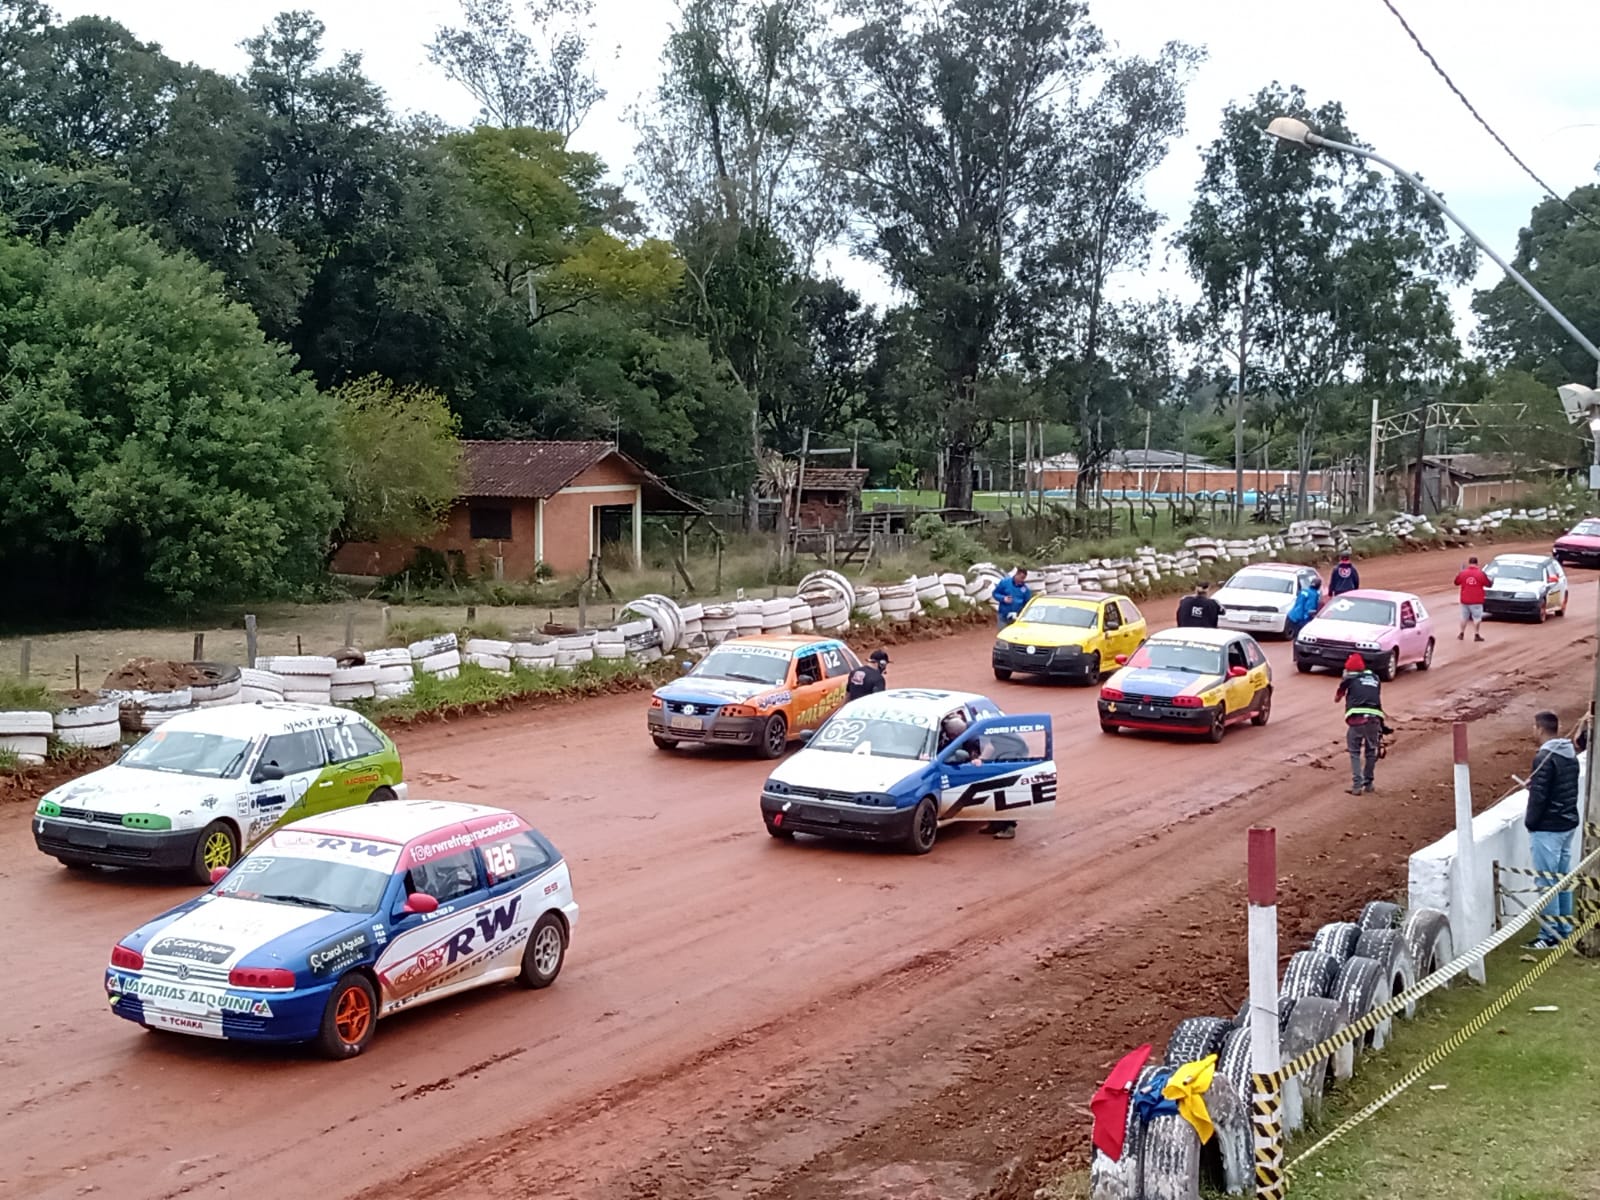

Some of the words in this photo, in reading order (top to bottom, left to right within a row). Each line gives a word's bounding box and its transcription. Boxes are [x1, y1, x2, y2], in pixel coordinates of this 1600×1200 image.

[823, 651, 841, 669] 02
[333, 726, 359, 759] 13
[821, 720, 867, 743] 62
[316, 837, 397, 858] RW
[484, 842, 517, 876] 126
[447, 893, 522, 967] RW
[174, 939, 200, 948] Carol
[321, 944, 342, 962] Carol
[342, 934, 365, 952] Aguiar
[124, 977, 186, 1001] LATARIAS
[188, 991, 252, 1013] ALQUINI
[169, 1017, 204, 1030] TCHAKA
